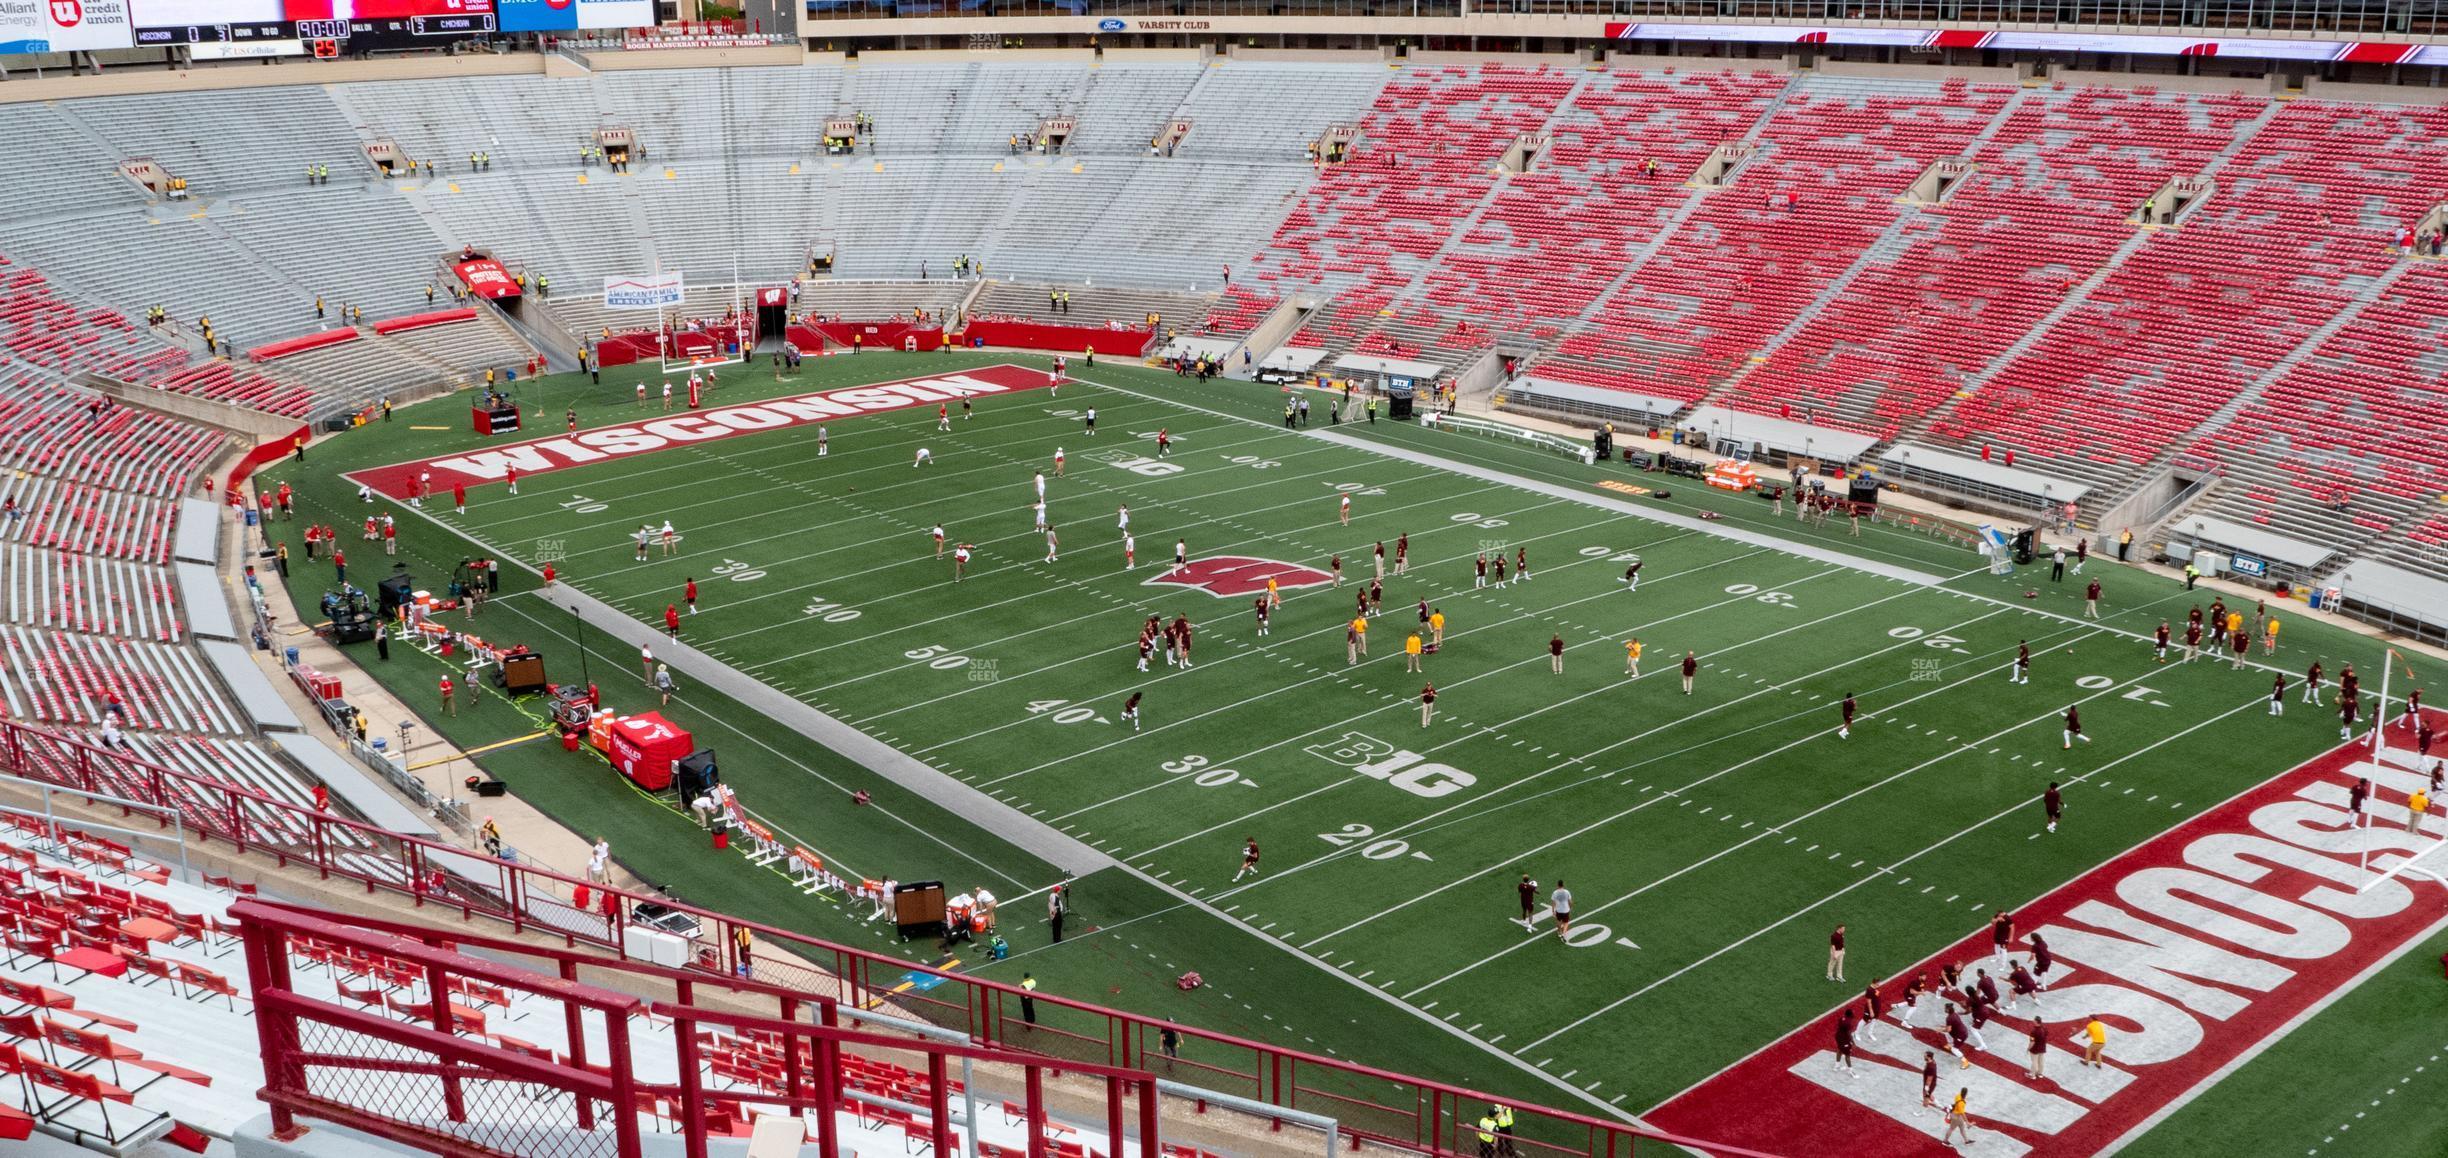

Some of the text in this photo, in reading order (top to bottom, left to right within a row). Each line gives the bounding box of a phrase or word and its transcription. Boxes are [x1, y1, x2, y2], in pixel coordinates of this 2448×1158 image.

[0, 2, 37, 14] Alliant
[84, 3, 121, 13] credit
[86, 14, 124, 24] union
[483, 15, 493, 30] 0
[1103, 21, 1120, 30] Ford
[1138, 21, 1210, 29] VARSITY CLUB
[188, 26, 199, 43] 0
[219, 31, 226, 42] 3
[234, 28, 252, 37] DOWN
[261, 27, 279, 36] TO GO
[300, 20, 347, 37] 90:00
[315, 40, 336, 56] 25
[609, 287, 677, 298] AMERICAN FAMILY
[612, 294, 673, 304] INSURANCE
[1391, 378, 1410, 387] BTN
[431, 374, 1010, 479] WISCONSIN
[1231, 455, 1281, 468] 30
[1335, 483, 1387, 496] 40
[559, 496, 608, 513] 10
[1451, 512, 1509, 529] 50
[712, 562, 767, 582] 30
[2235, 557, 2260, 572] BTN
[1725, 584, 1794, 603] 30
[802, 604, 862, 622] 40
[1888, 627, 1967, 648] 20
[905, 645, 970, 669] 50
[2075, 676, 2162, 701] 10
[1025, 700, 1095, 724] 40
[615, 740, 642, 760] MUELLER
[1161, 755, 1240, 786] 30
[1317, 823, 1410, 860] 20
[1509, 902, 1612, 947] 10
